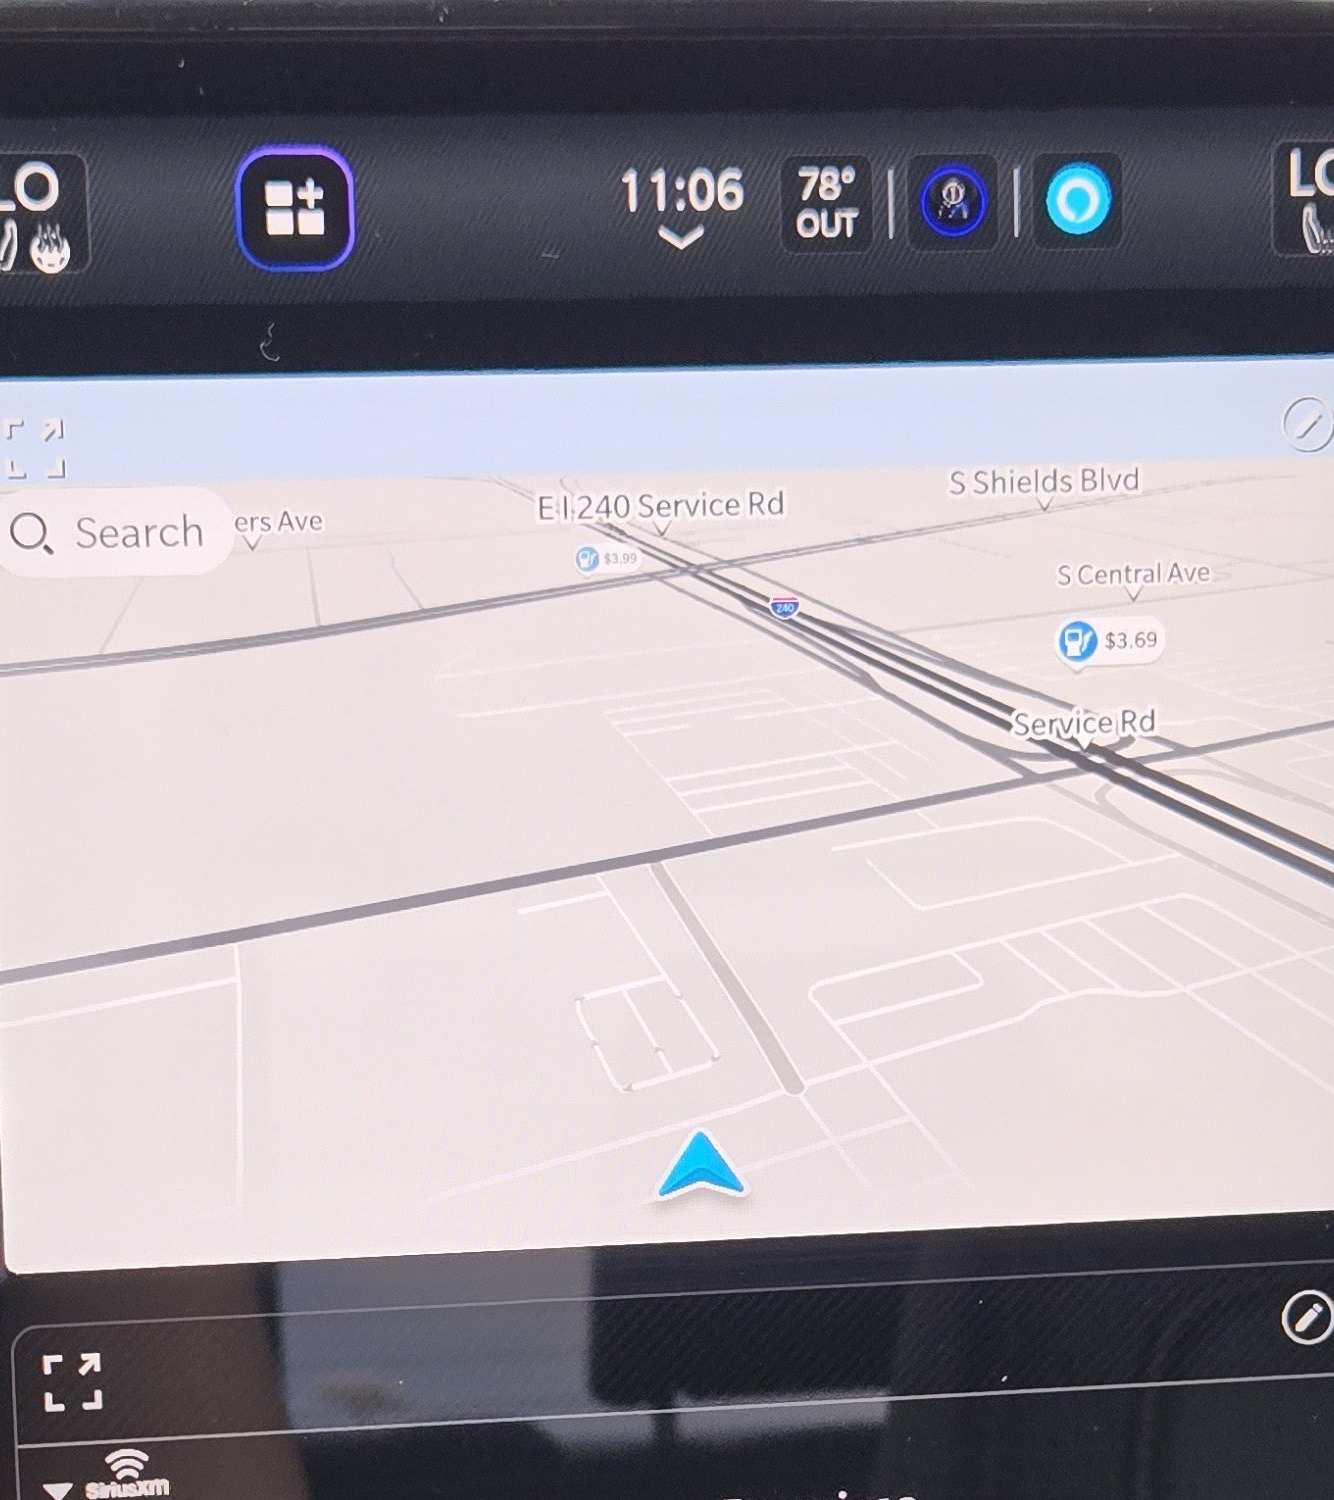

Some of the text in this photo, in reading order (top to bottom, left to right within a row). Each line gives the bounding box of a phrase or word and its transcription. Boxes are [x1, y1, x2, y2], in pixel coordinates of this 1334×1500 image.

[621, 165, 745, 214] 11:06
[798, 164, 856, 202] 78°
[796, 207, 860, 238] OUT
[949, 466, 1140, 496] S Shields Blvd
[539, 496, 554, 519] E
[577, 494, 630, 519] 240
[638, 491, 740, 518] Service
[748, 491, 784, 515] Rd
[75, 511, 204, 549] Search
[277, 511, 323, 532] Ave
[1057, 562, 1211, 587] S Central Ave
[1104, 628, 1158, 651] $3.69
[1013, 709, 1156, 737] Service Rd
